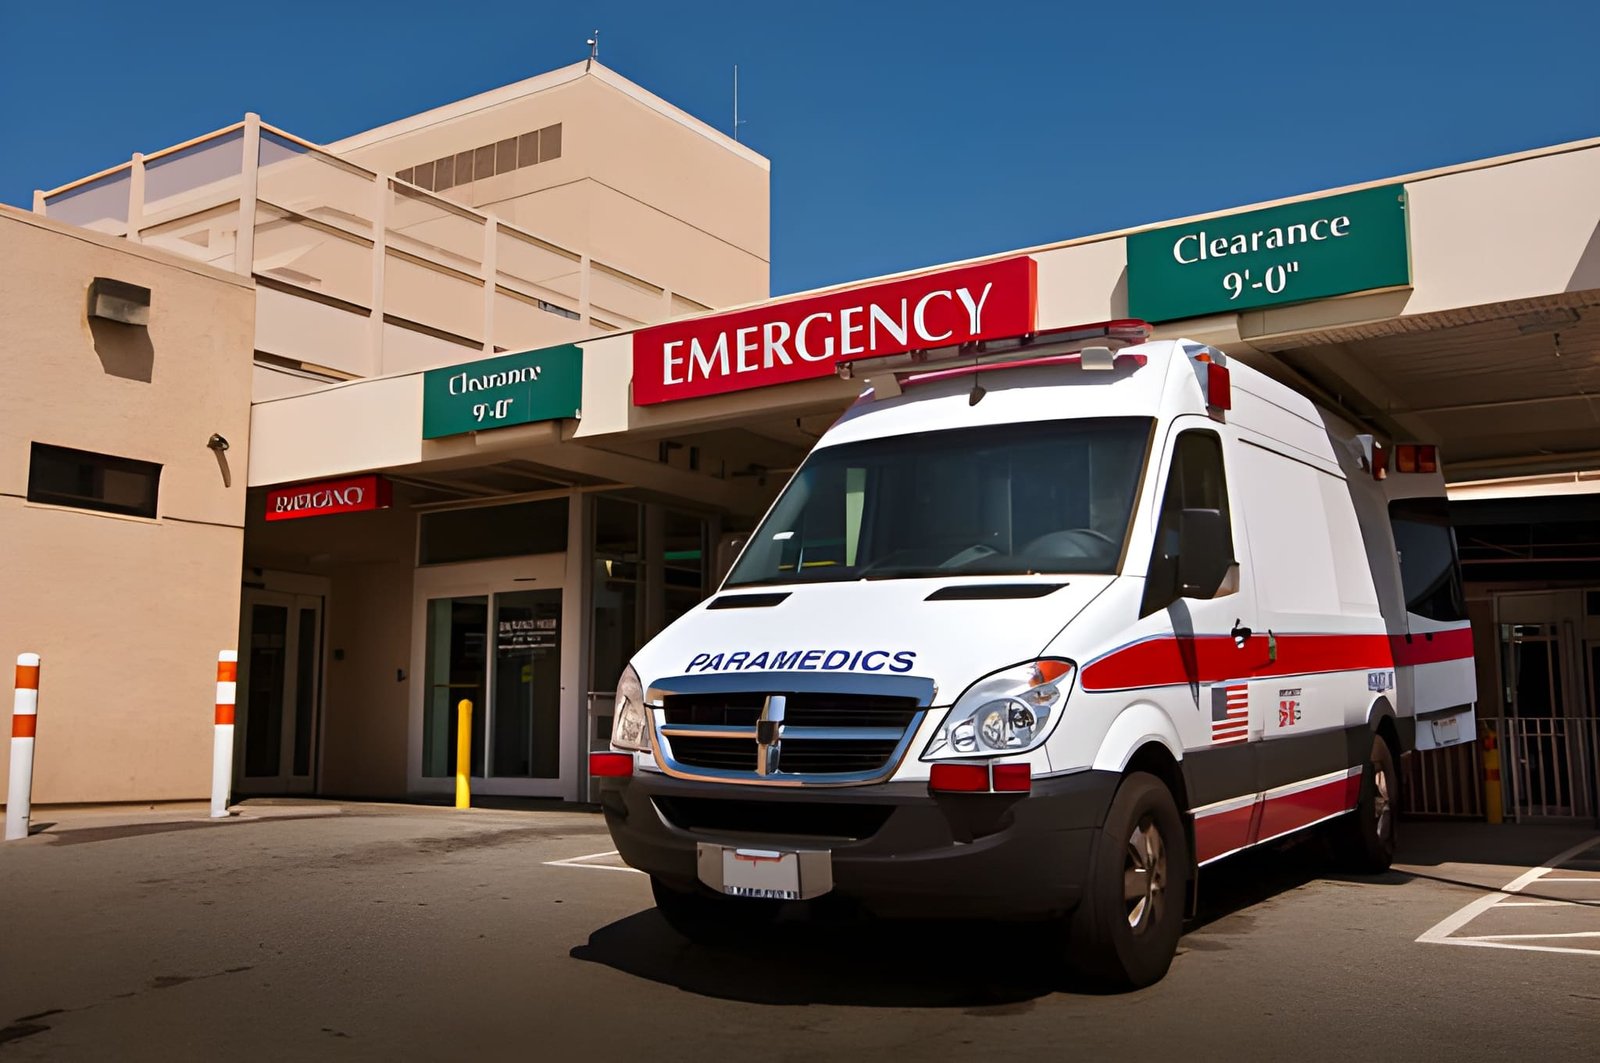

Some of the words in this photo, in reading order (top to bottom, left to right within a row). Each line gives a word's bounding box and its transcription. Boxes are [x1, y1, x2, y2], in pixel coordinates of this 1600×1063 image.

[1172, 214, 1350, 265] Clearance
[1222, 261, 1299, 300] 9'-0"
[662, 282, 993, 386] EMERGENCY
[685, 649, 917, 673] PARAMEDICS
